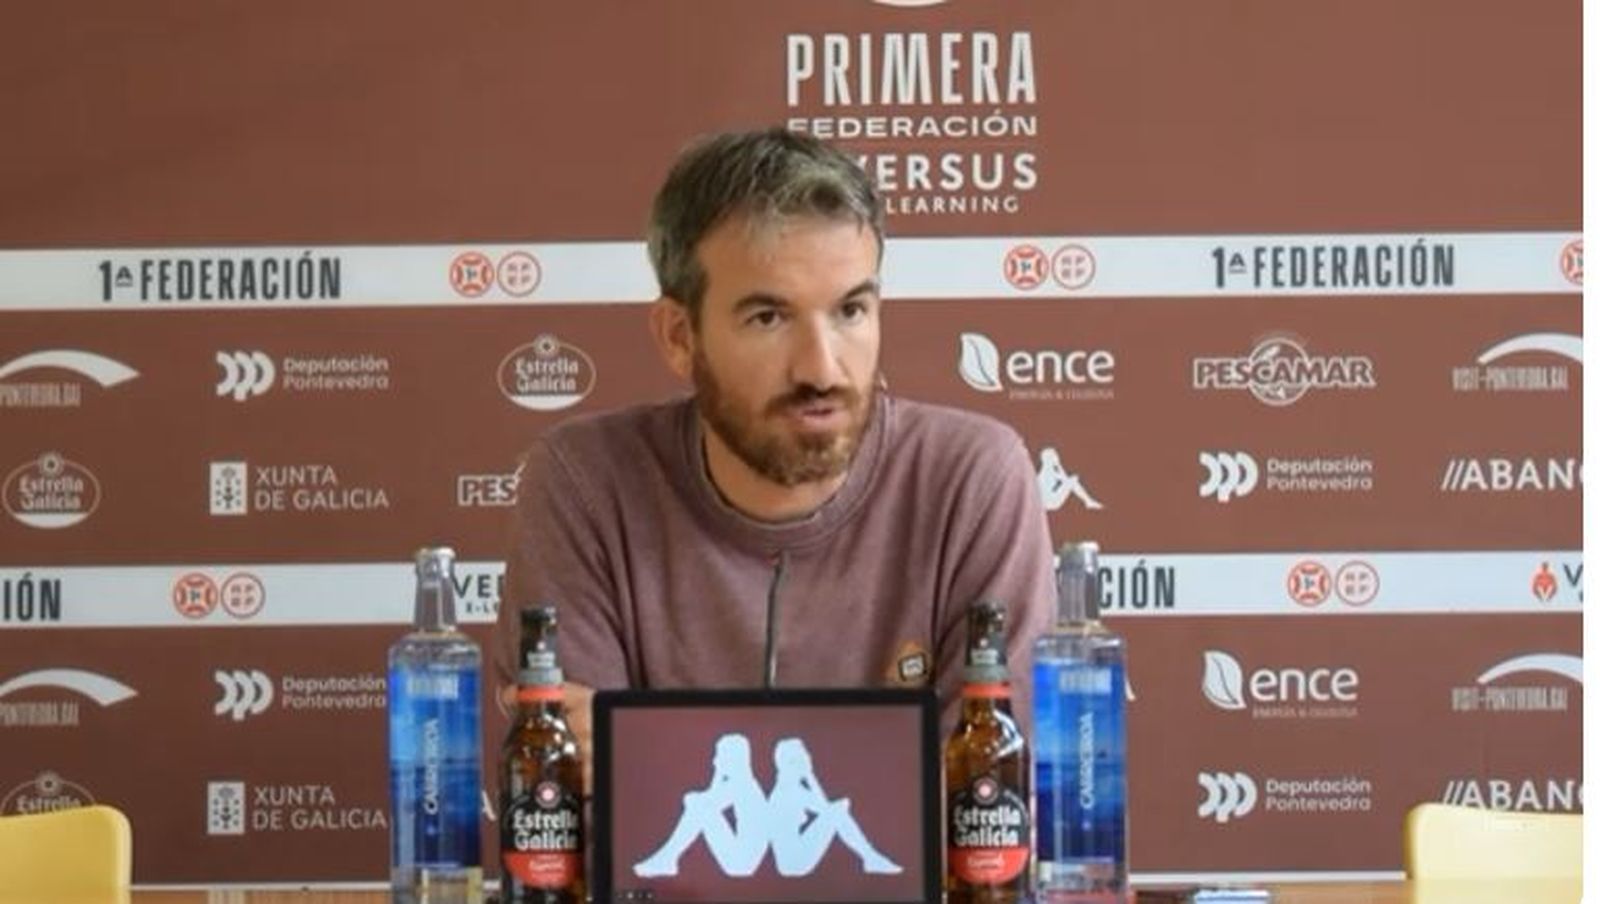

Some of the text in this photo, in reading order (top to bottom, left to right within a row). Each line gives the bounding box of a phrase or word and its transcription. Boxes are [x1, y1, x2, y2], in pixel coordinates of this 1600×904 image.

[787, 32, 1037, 106] PRIMERA
[788, 110, 1037, 138] FEDERACIÓN
[1253, 239, 1454, 287] FEDERACIÓN
[140, 251, 341, 301] FEDERACIÓN
[283, 356, 389, 374] Deputación
[515, 357, 580, 376] Estrella
[1006, 350, 1115, 384] ence
[1194, 357, 1377, 389] PESCAMAR
[283, 374, 389, 391] Pontevedra
[516, 374, 577, 393] Galicia
[255, 465, 338, 486] XUNTA
[1266, 457, 1373, 477] Deputación
[1266, 475, 1373, 491] Pontevedra
[255, 488, 390, 511] DE GALICIA
[281, 672, 387, 693] Deputación
[1249, 668, 1359, 702] ence
[281, 692, 387, 709] Pontevedra
[253, 785, 335, 807] XUNTA
[1265, 777, 1371, 796] Deputación
[1265, 795, 1371, 812] Pontevedra
[252, 807, 388, 831] DE GALICIA
[954, 804, 1021, 827] Estrella
